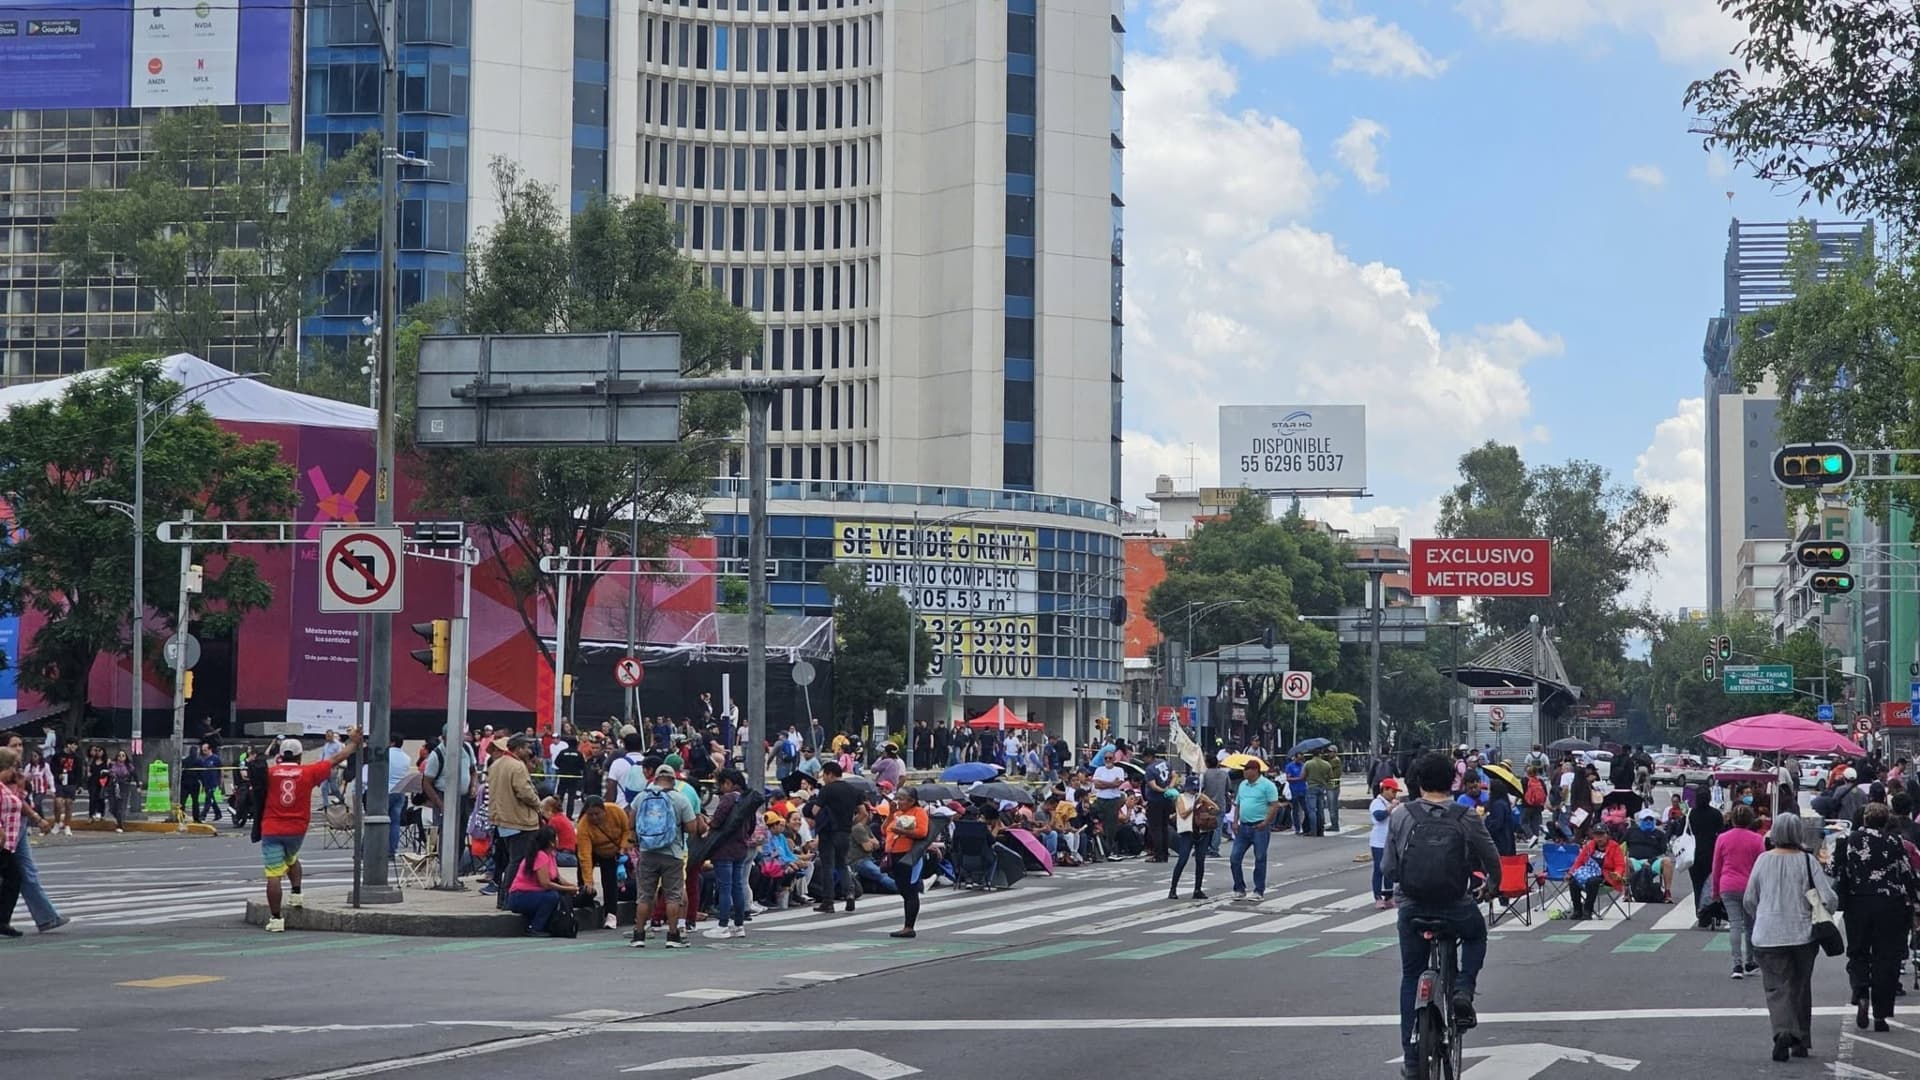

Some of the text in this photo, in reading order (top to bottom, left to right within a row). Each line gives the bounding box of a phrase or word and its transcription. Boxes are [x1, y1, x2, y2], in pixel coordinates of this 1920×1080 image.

[41, 25, 78, 34] Google Play
[1252, 438, 1331, 454] DISPONIBLE
[1241, 455, 1344, 472] 55 6296 5037
[842, 527, 872, 555] SE
[878, 528, 953, 559] VENDE
[977, 533, 1032, 562] RENTA
[1426, 548, 1534, 564] EXCLUSIVO
[865, 564, 1019, 588] EDIFICIO COMPLETO
[1427, 572, 1534, 587] METROBUS
[305, 627, 327, 635] México
[332, 628, 351, 636] través
[974, 619, 1032, 648] 3399
[325, 636, 350, 644] sentidos
[974, 649, 1032, 677] 0000
[283, 780, 294, 804] 8
